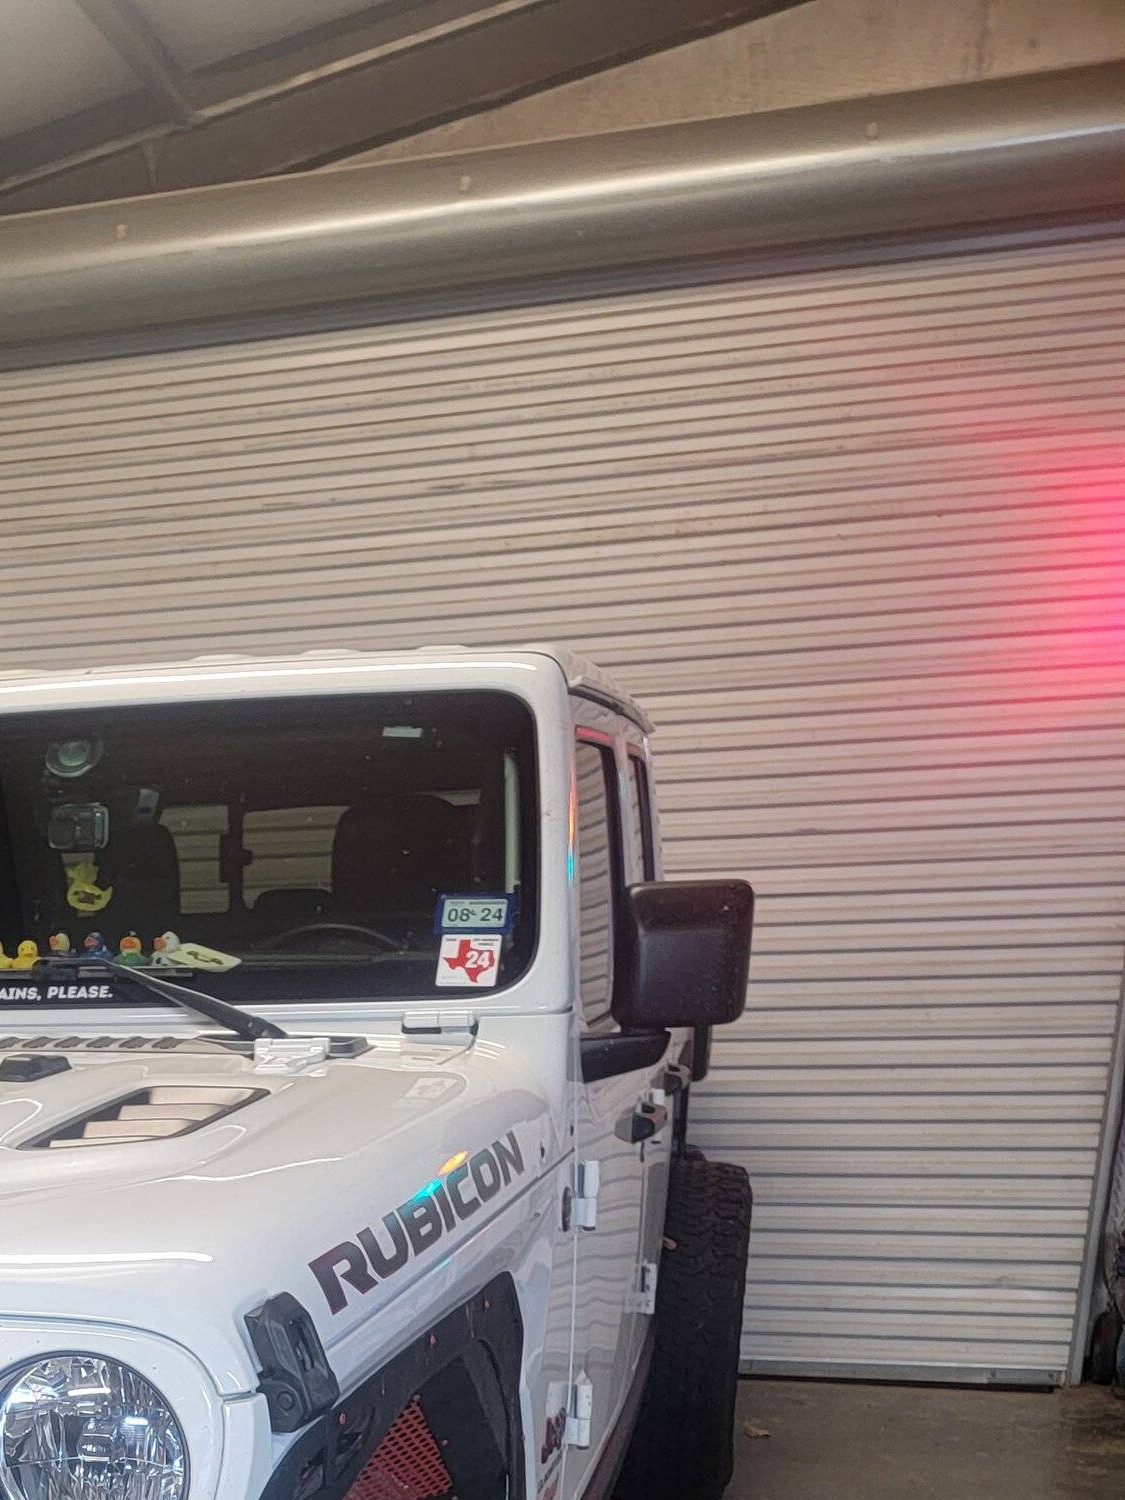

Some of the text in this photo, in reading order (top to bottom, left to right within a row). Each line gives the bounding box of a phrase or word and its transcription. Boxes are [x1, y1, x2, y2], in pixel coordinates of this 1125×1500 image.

[480, 908, 503, 922] 24
[464, 950, 491, 969] 24
[47, 985, 113, 999] PLEASE.
[307, 1130, 524, 1315] RUBICON
